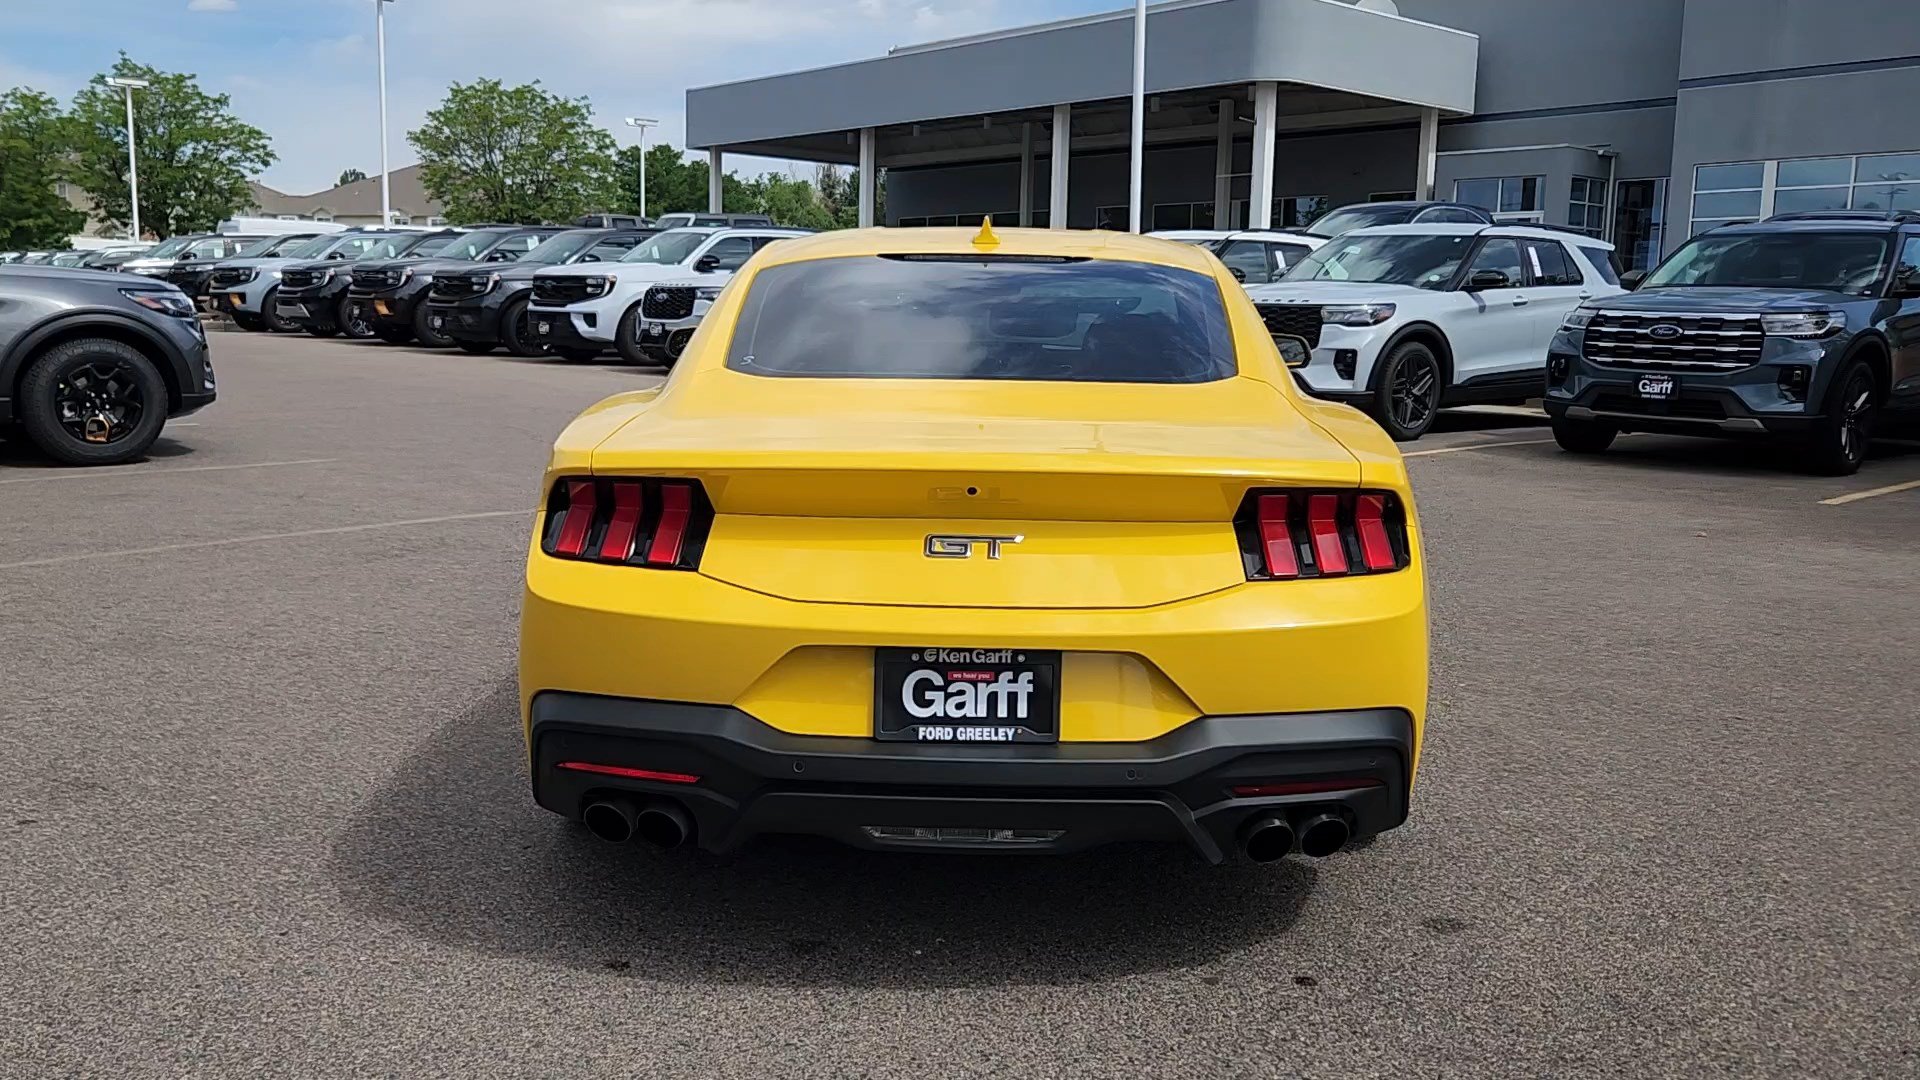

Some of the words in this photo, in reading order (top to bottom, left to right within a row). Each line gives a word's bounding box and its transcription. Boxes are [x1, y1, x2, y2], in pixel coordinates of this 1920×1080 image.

[1638, 379, 1673, 394] Garff
[923, 534, 1024, 560] GT
[938, 649, 970, 663] Ken
[972, 649, 1012, 664] Garff
[902, 669, 1034, 719] Garff
[918, 727, 953, 741] FORD
[956, 727, 1016, 742] GREELEY
